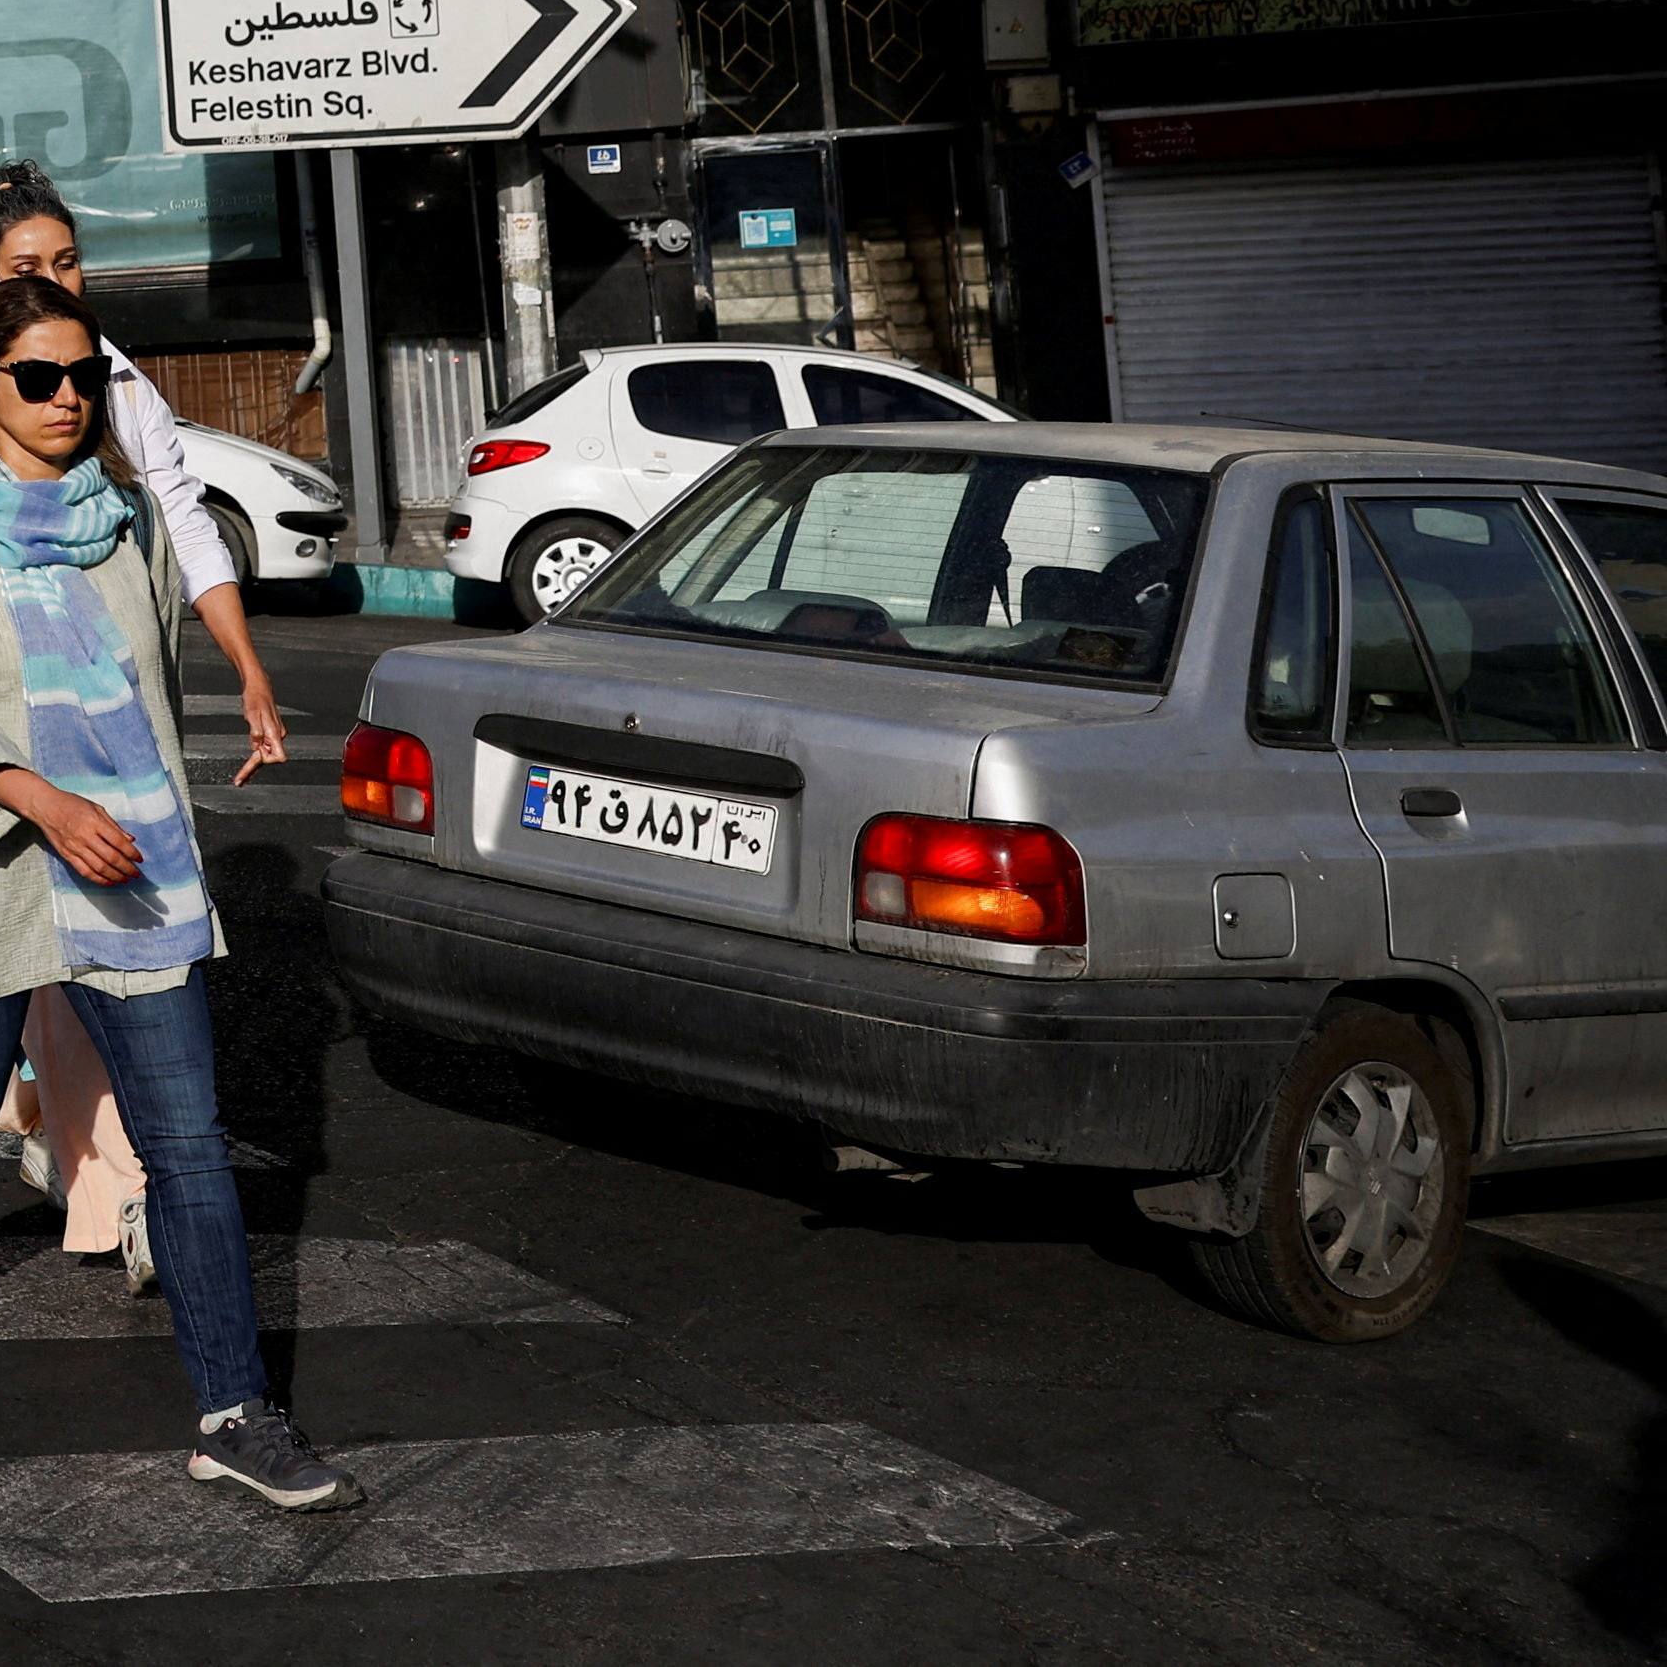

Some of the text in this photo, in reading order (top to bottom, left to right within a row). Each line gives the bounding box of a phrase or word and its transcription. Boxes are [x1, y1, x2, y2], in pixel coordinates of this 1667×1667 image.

[189, 47, 438, 86] Keshavarz Blvd.
[191, 90, 373, 123] Felestin Sq.
[522, 814, 543, 826] IRAN
[727, 805, 766, 822] ایران
